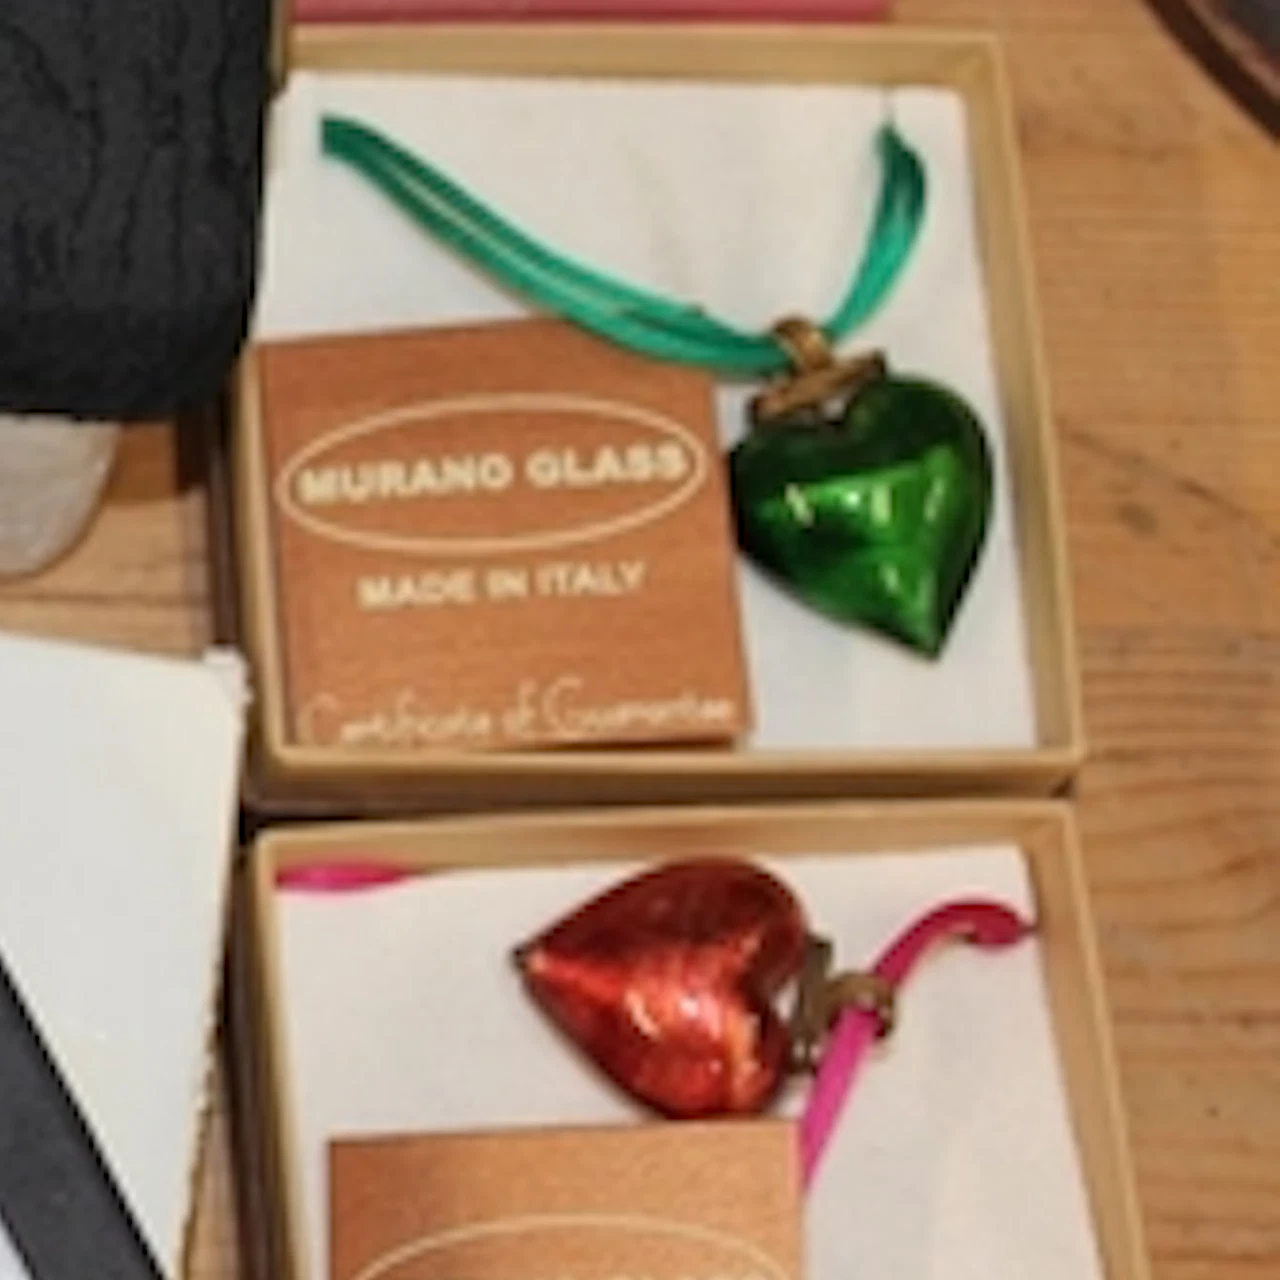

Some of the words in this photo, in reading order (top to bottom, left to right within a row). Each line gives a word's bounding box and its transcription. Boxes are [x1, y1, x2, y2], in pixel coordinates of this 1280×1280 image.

[299, 453, 512, 506] MURANO
[527, 441, 688, 487] GLASS
[357, 567, 477, 609] MADE
[487, 565, 527, 602] IN
[538, 559, 648, 600] ITALY
